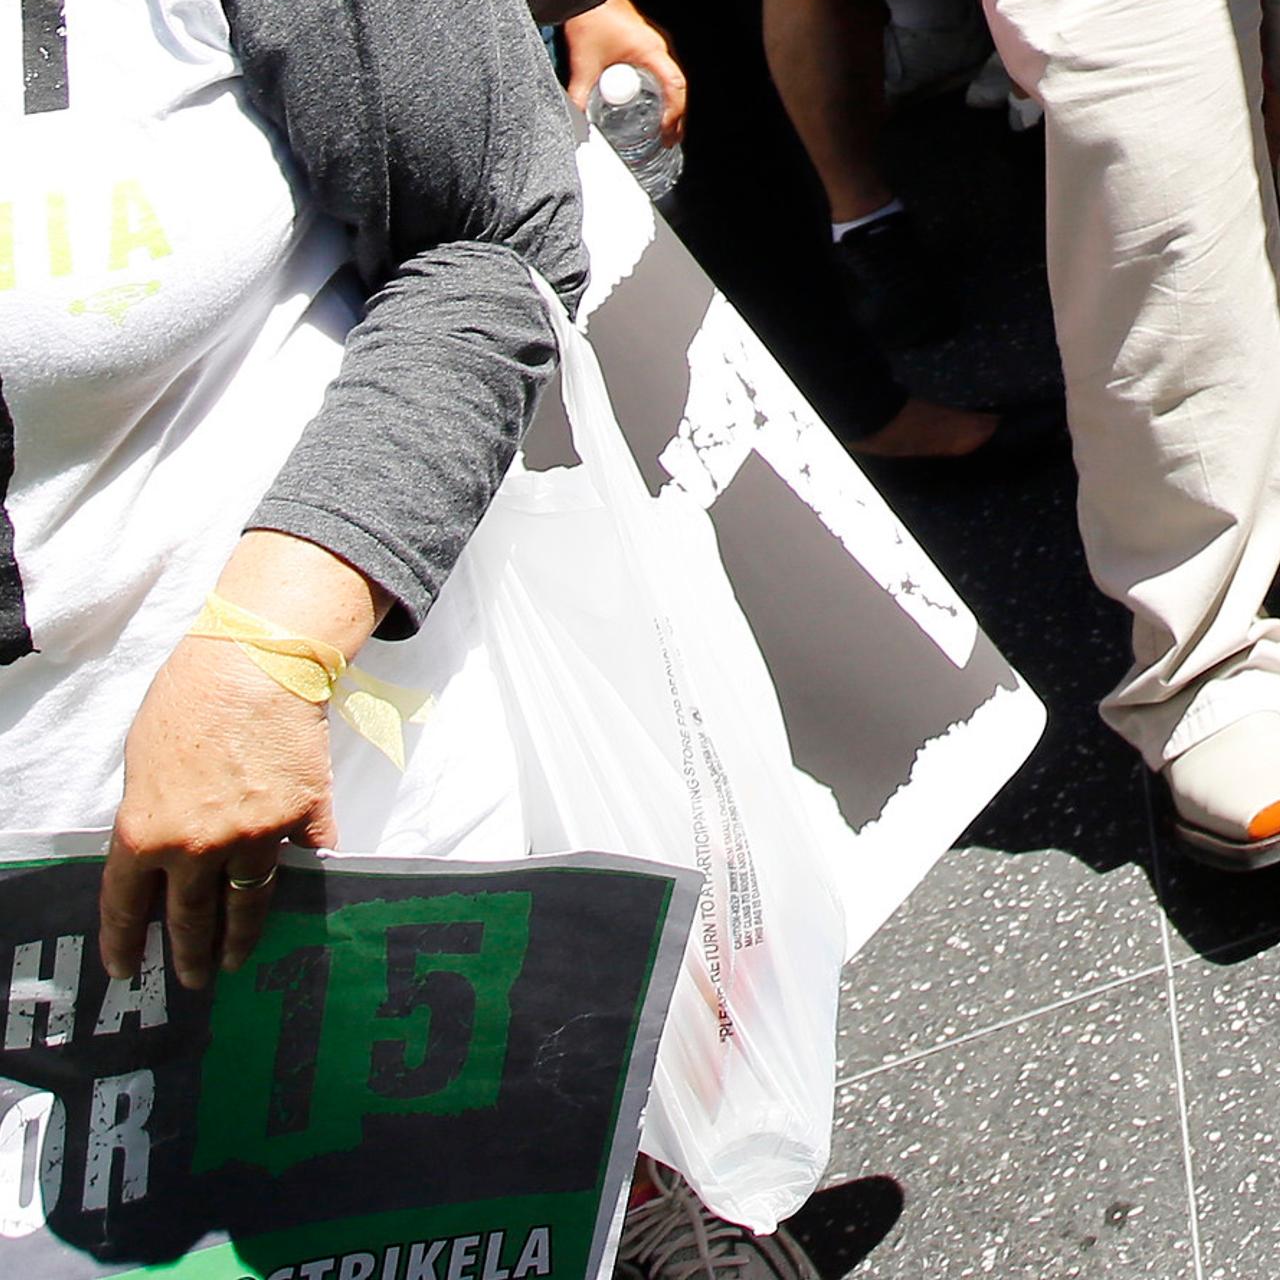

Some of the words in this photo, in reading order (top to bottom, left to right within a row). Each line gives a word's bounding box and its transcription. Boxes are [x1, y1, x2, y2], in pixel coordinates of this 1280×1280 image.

[701, 901, 716, 922] TO
[702, 923, 721, 983] RETURN
[254, 921, 487, 1139] 15
